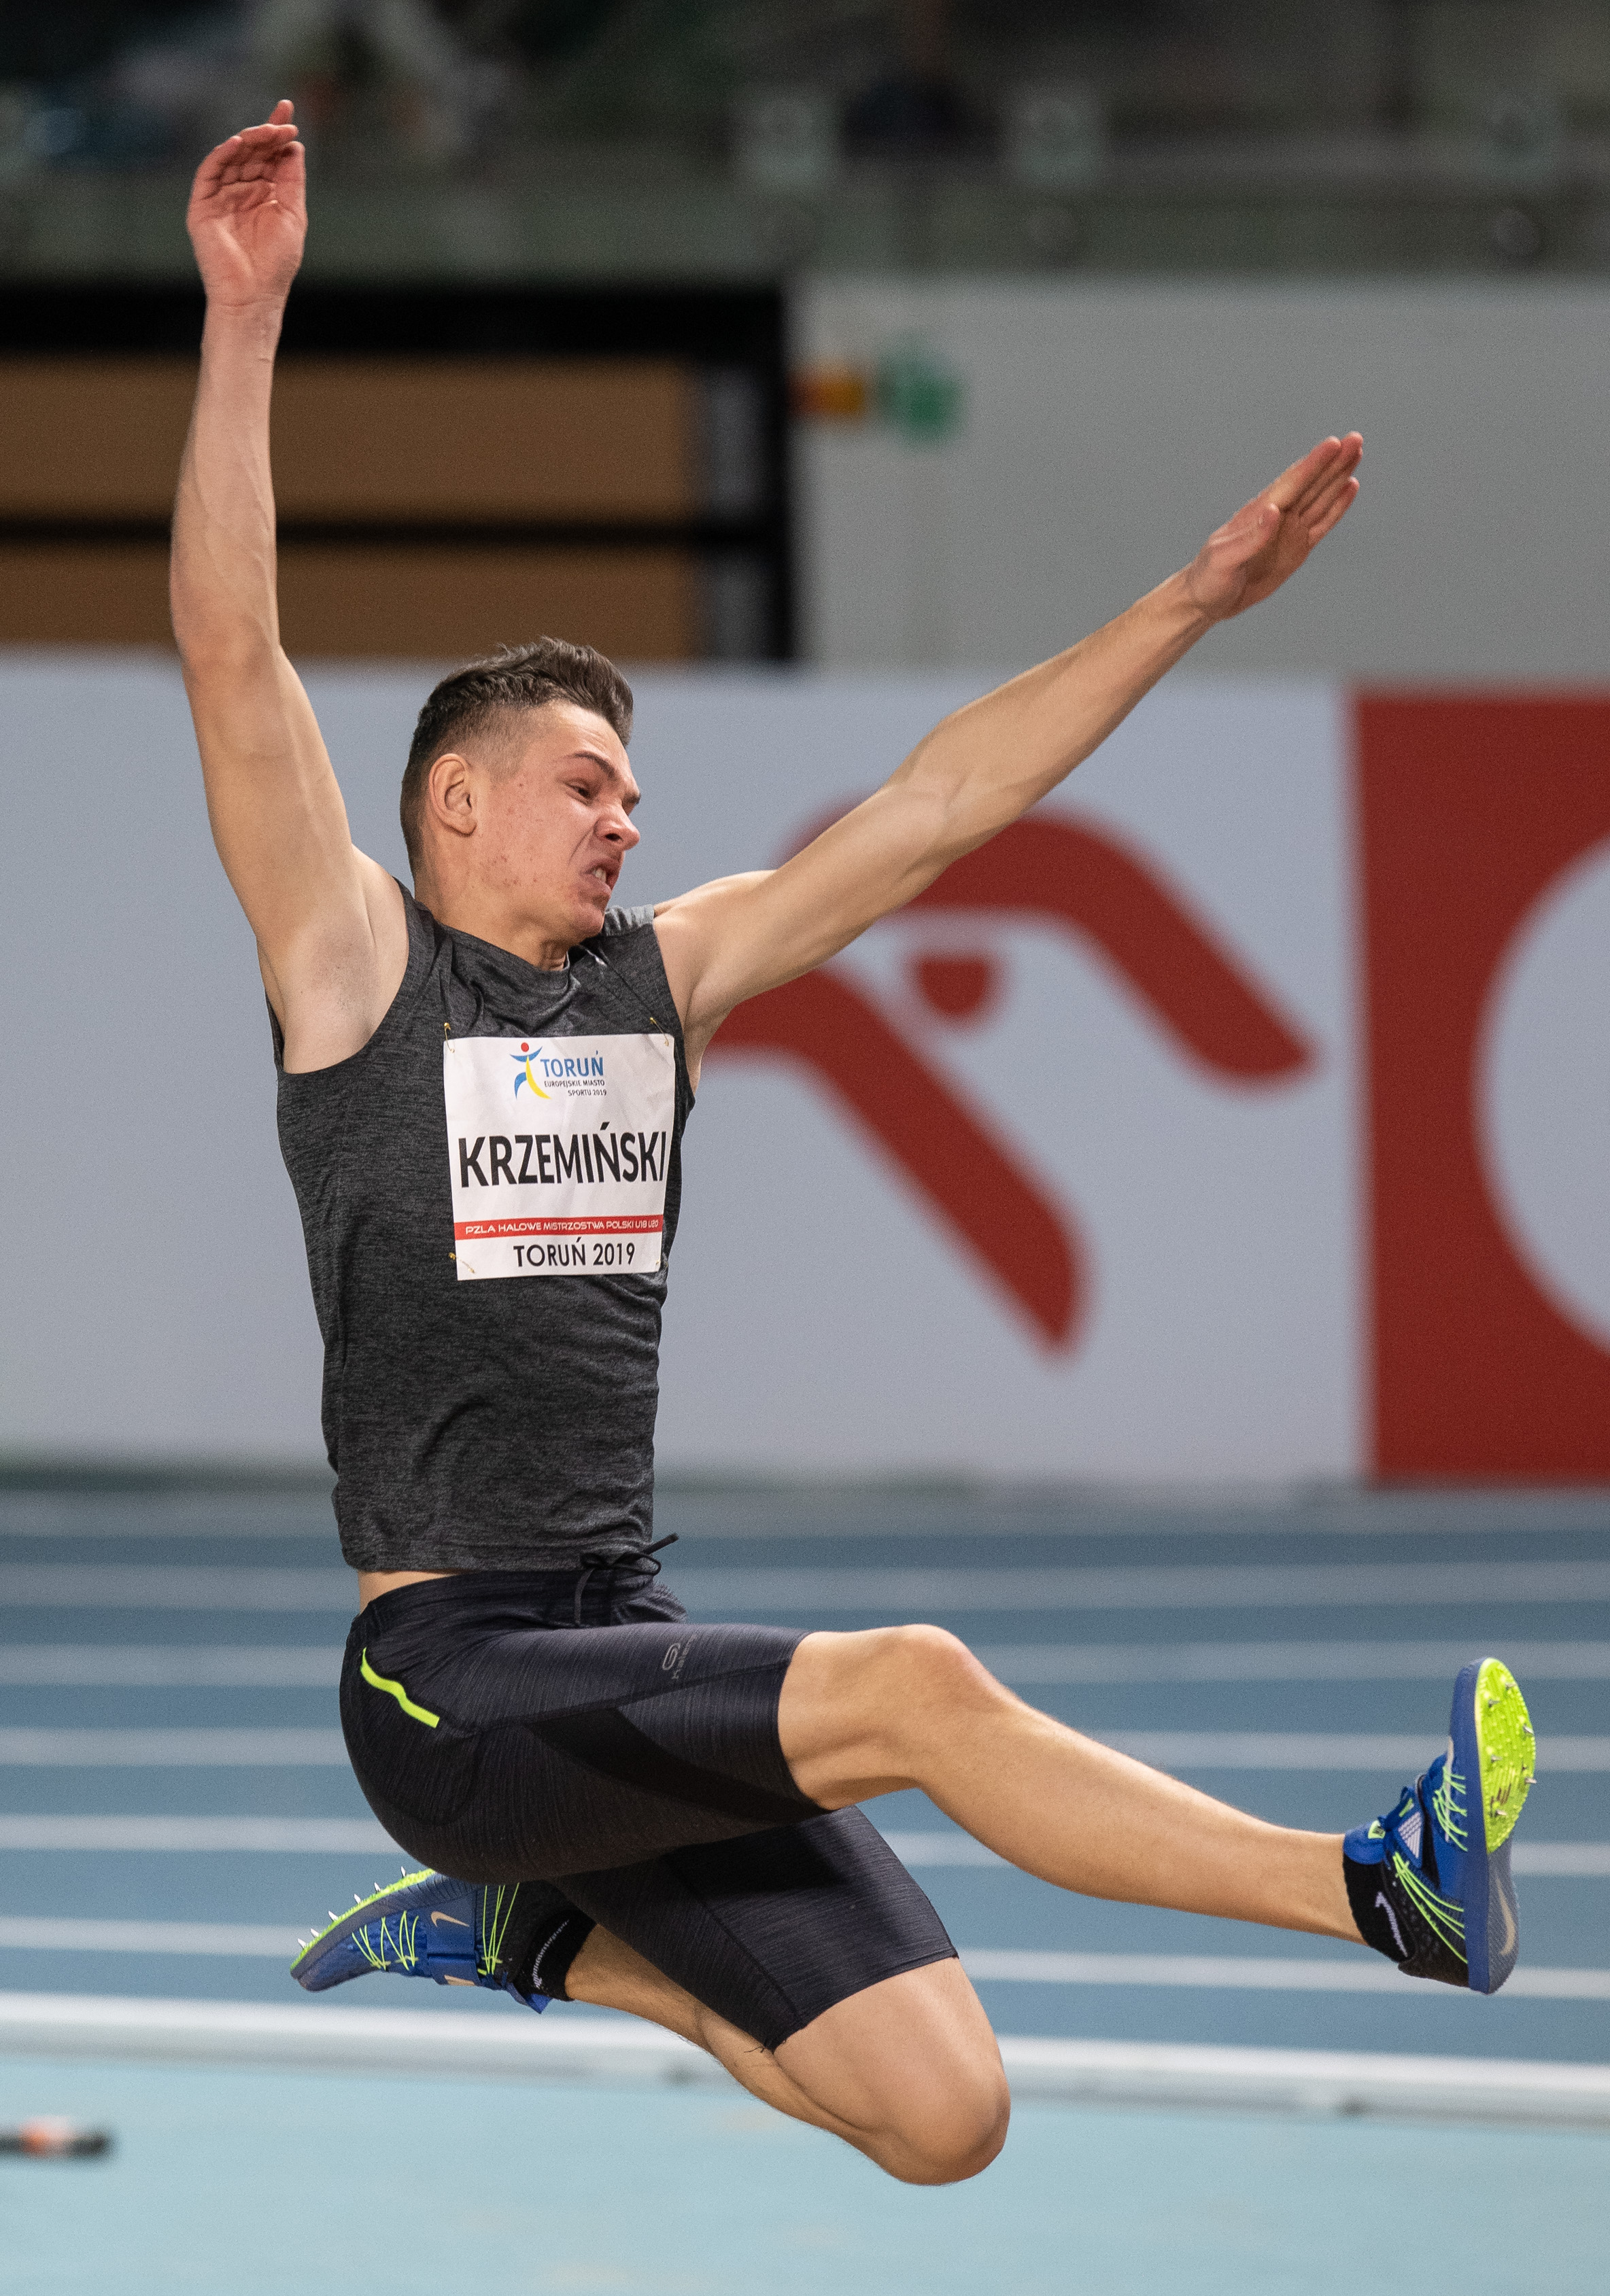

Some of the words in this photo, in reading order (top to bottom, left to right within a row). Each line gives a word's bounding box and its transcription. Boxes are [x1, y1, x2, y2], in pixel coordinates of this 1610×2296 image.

[540, 1049, 604, 1078] TORUŃ
[544, 1080, 582, 1088] EUROPEJSKIE
[458, 1121, 667, 1188] KRZEMIŃSKI
[465, 1225, 496, 1235] PZLA
[498, 1222, 542, 1233] HALOWE
[543, 1221, 604, 1231] MISTRZOSTWA
[606, 1220, 634, 1230] POLSKI
[513, 1236, 586, 1268] TORUŃ
[593, 1242, 635, 1266] 2019
